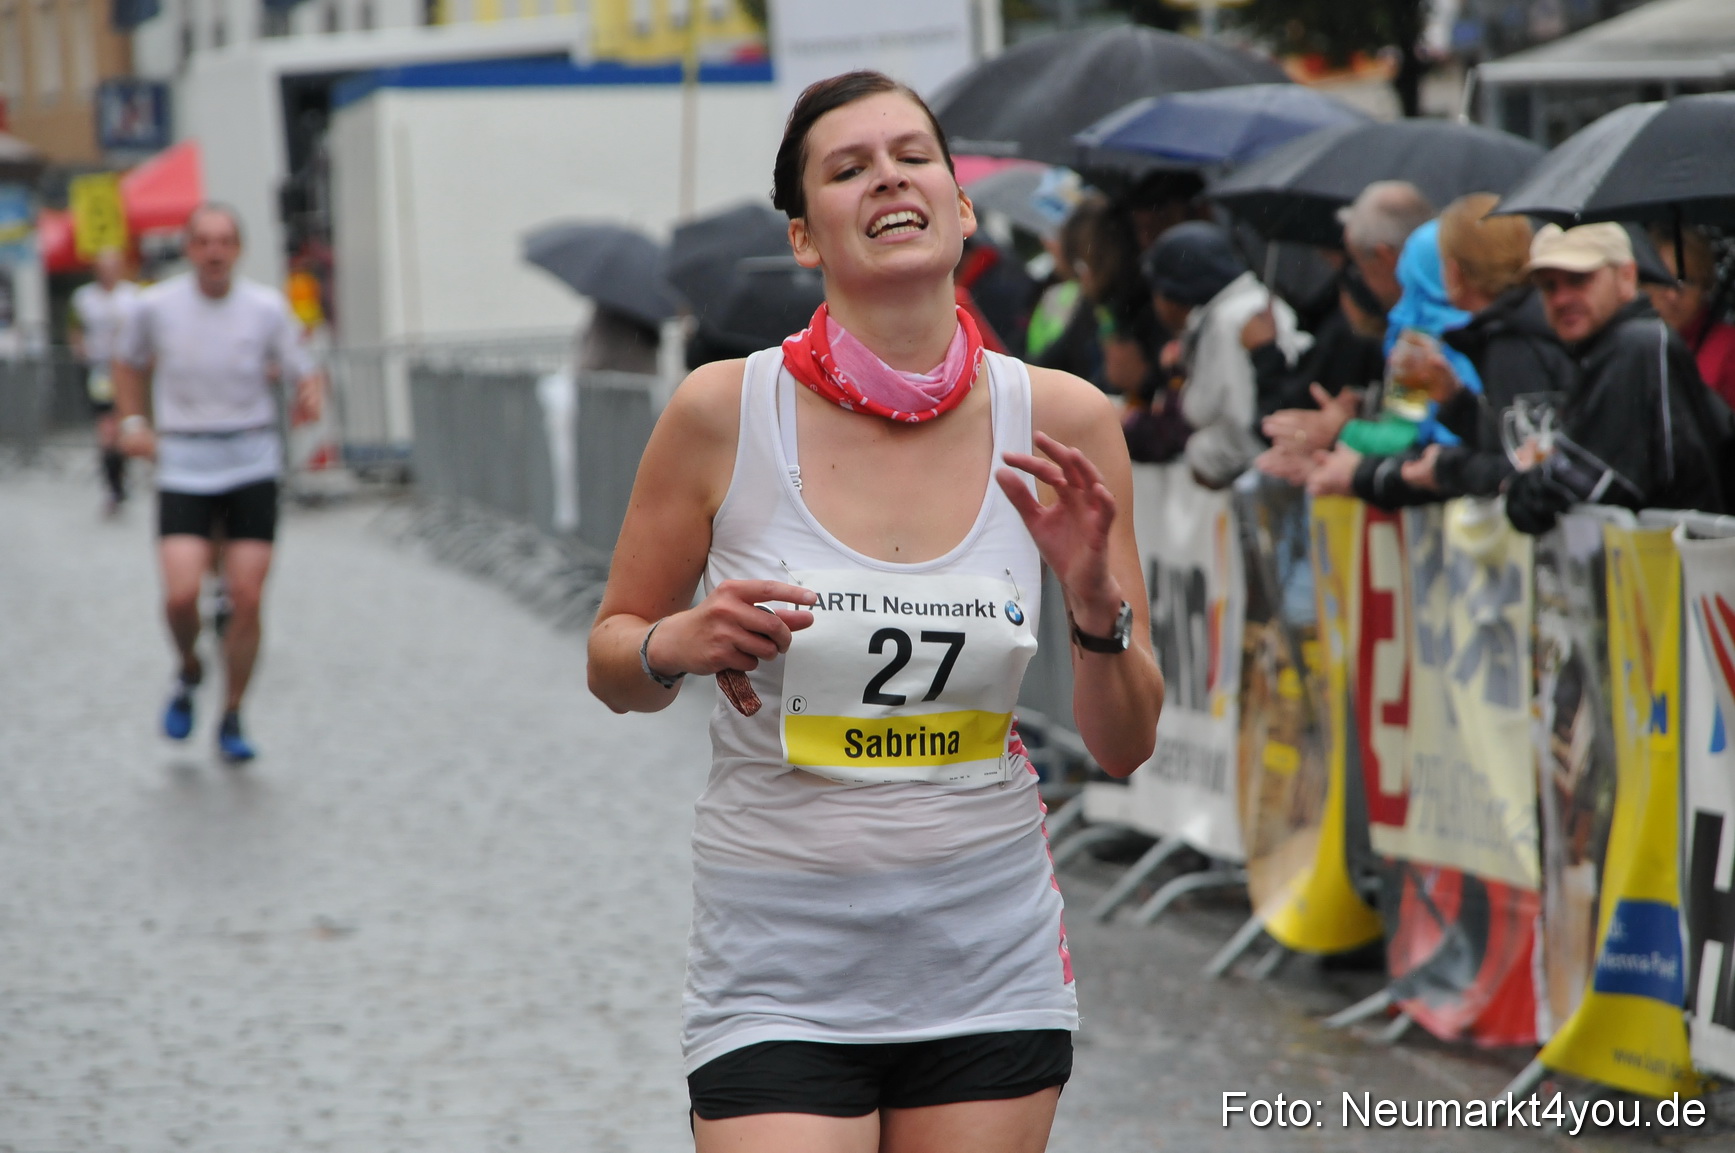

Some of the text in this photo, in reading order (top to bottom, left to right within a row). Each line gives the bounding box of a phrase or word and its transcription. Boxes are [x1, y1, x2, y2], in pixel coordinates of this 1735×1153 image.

[795, 592, 876, 613] ARTL
[883, 596, 997, 619] Neumarkt
[861, 627, 966, 707] 27
[844, 726, 960, 759] Sabrina
